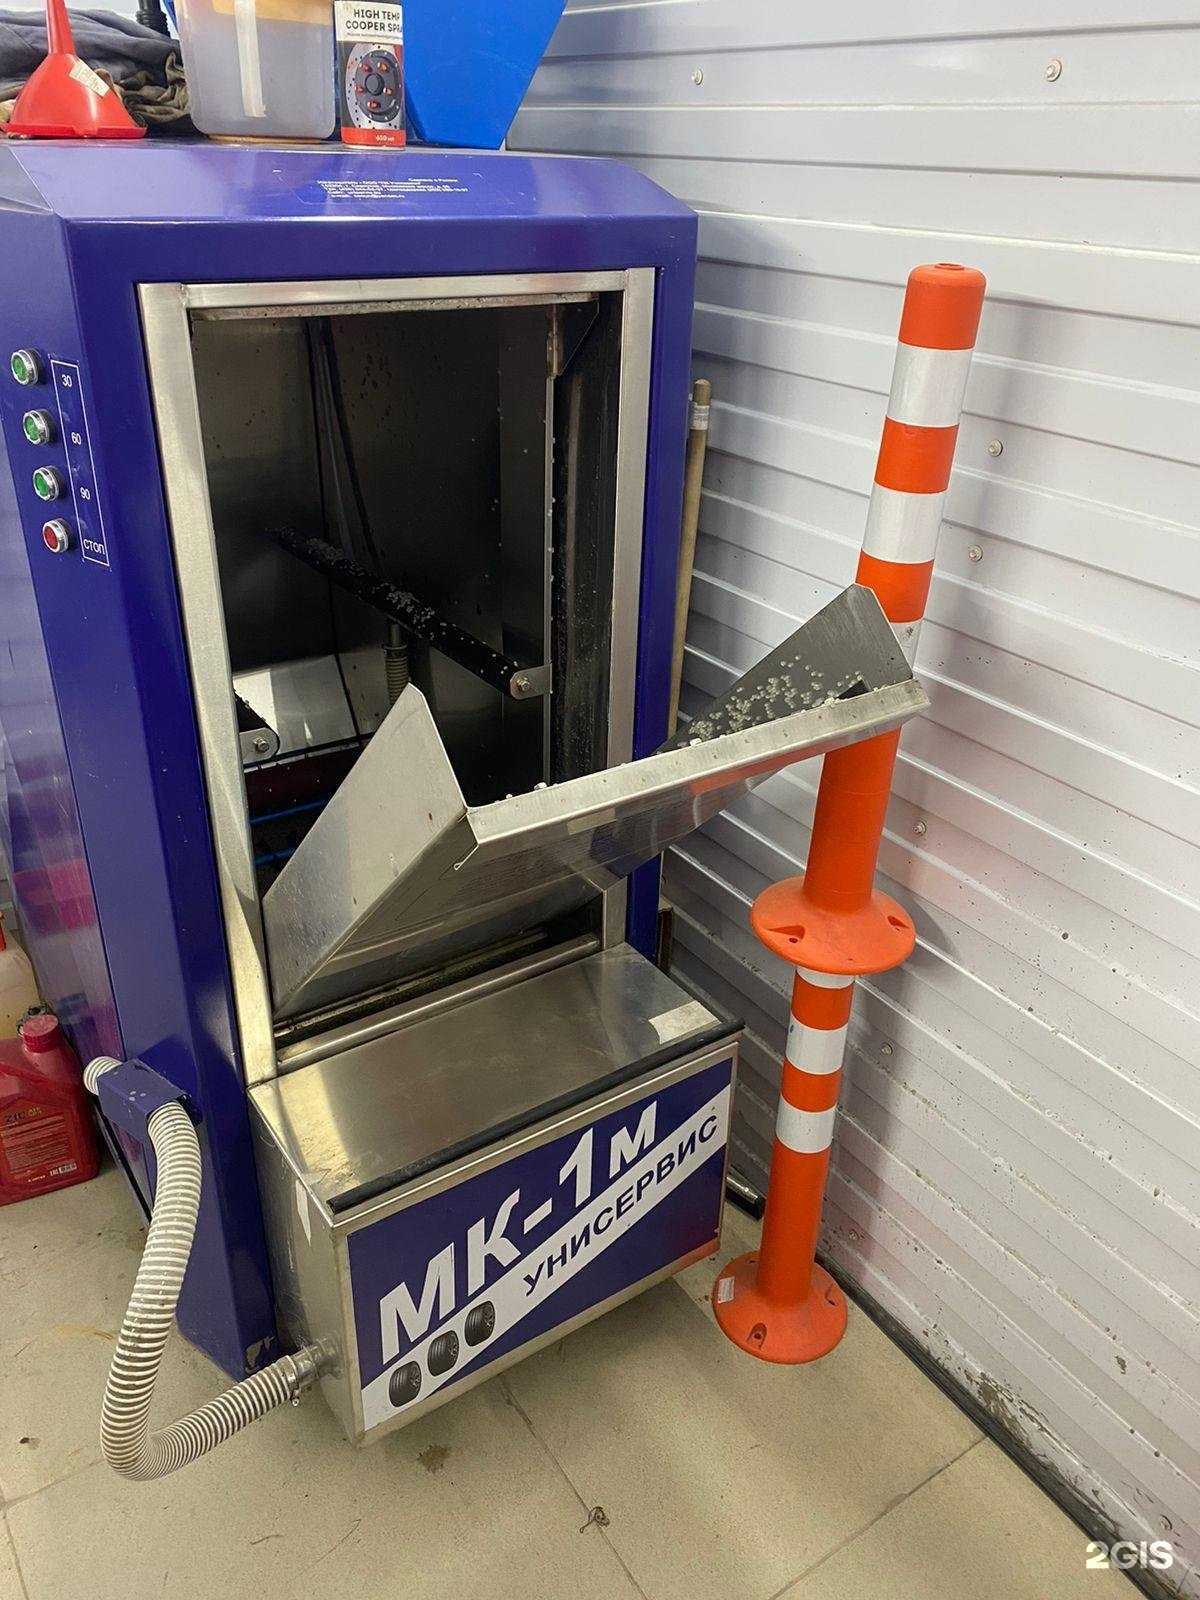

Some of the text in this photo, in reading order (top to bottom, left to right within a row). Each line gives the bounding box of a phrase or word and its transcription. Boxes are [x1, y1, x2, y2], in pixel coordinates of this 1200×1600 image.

[353, 9, 380, 19] HIGH
[345, 20, 386, 31] COOPER
[61, 374, 73, 387] 30
[71, 432, 82, 445] 60
[79, 487, 91, 500] 90
[83, 538, 106, 555] СТОП
[523, 1114, 718, 1297] УНИСЕРВИС
